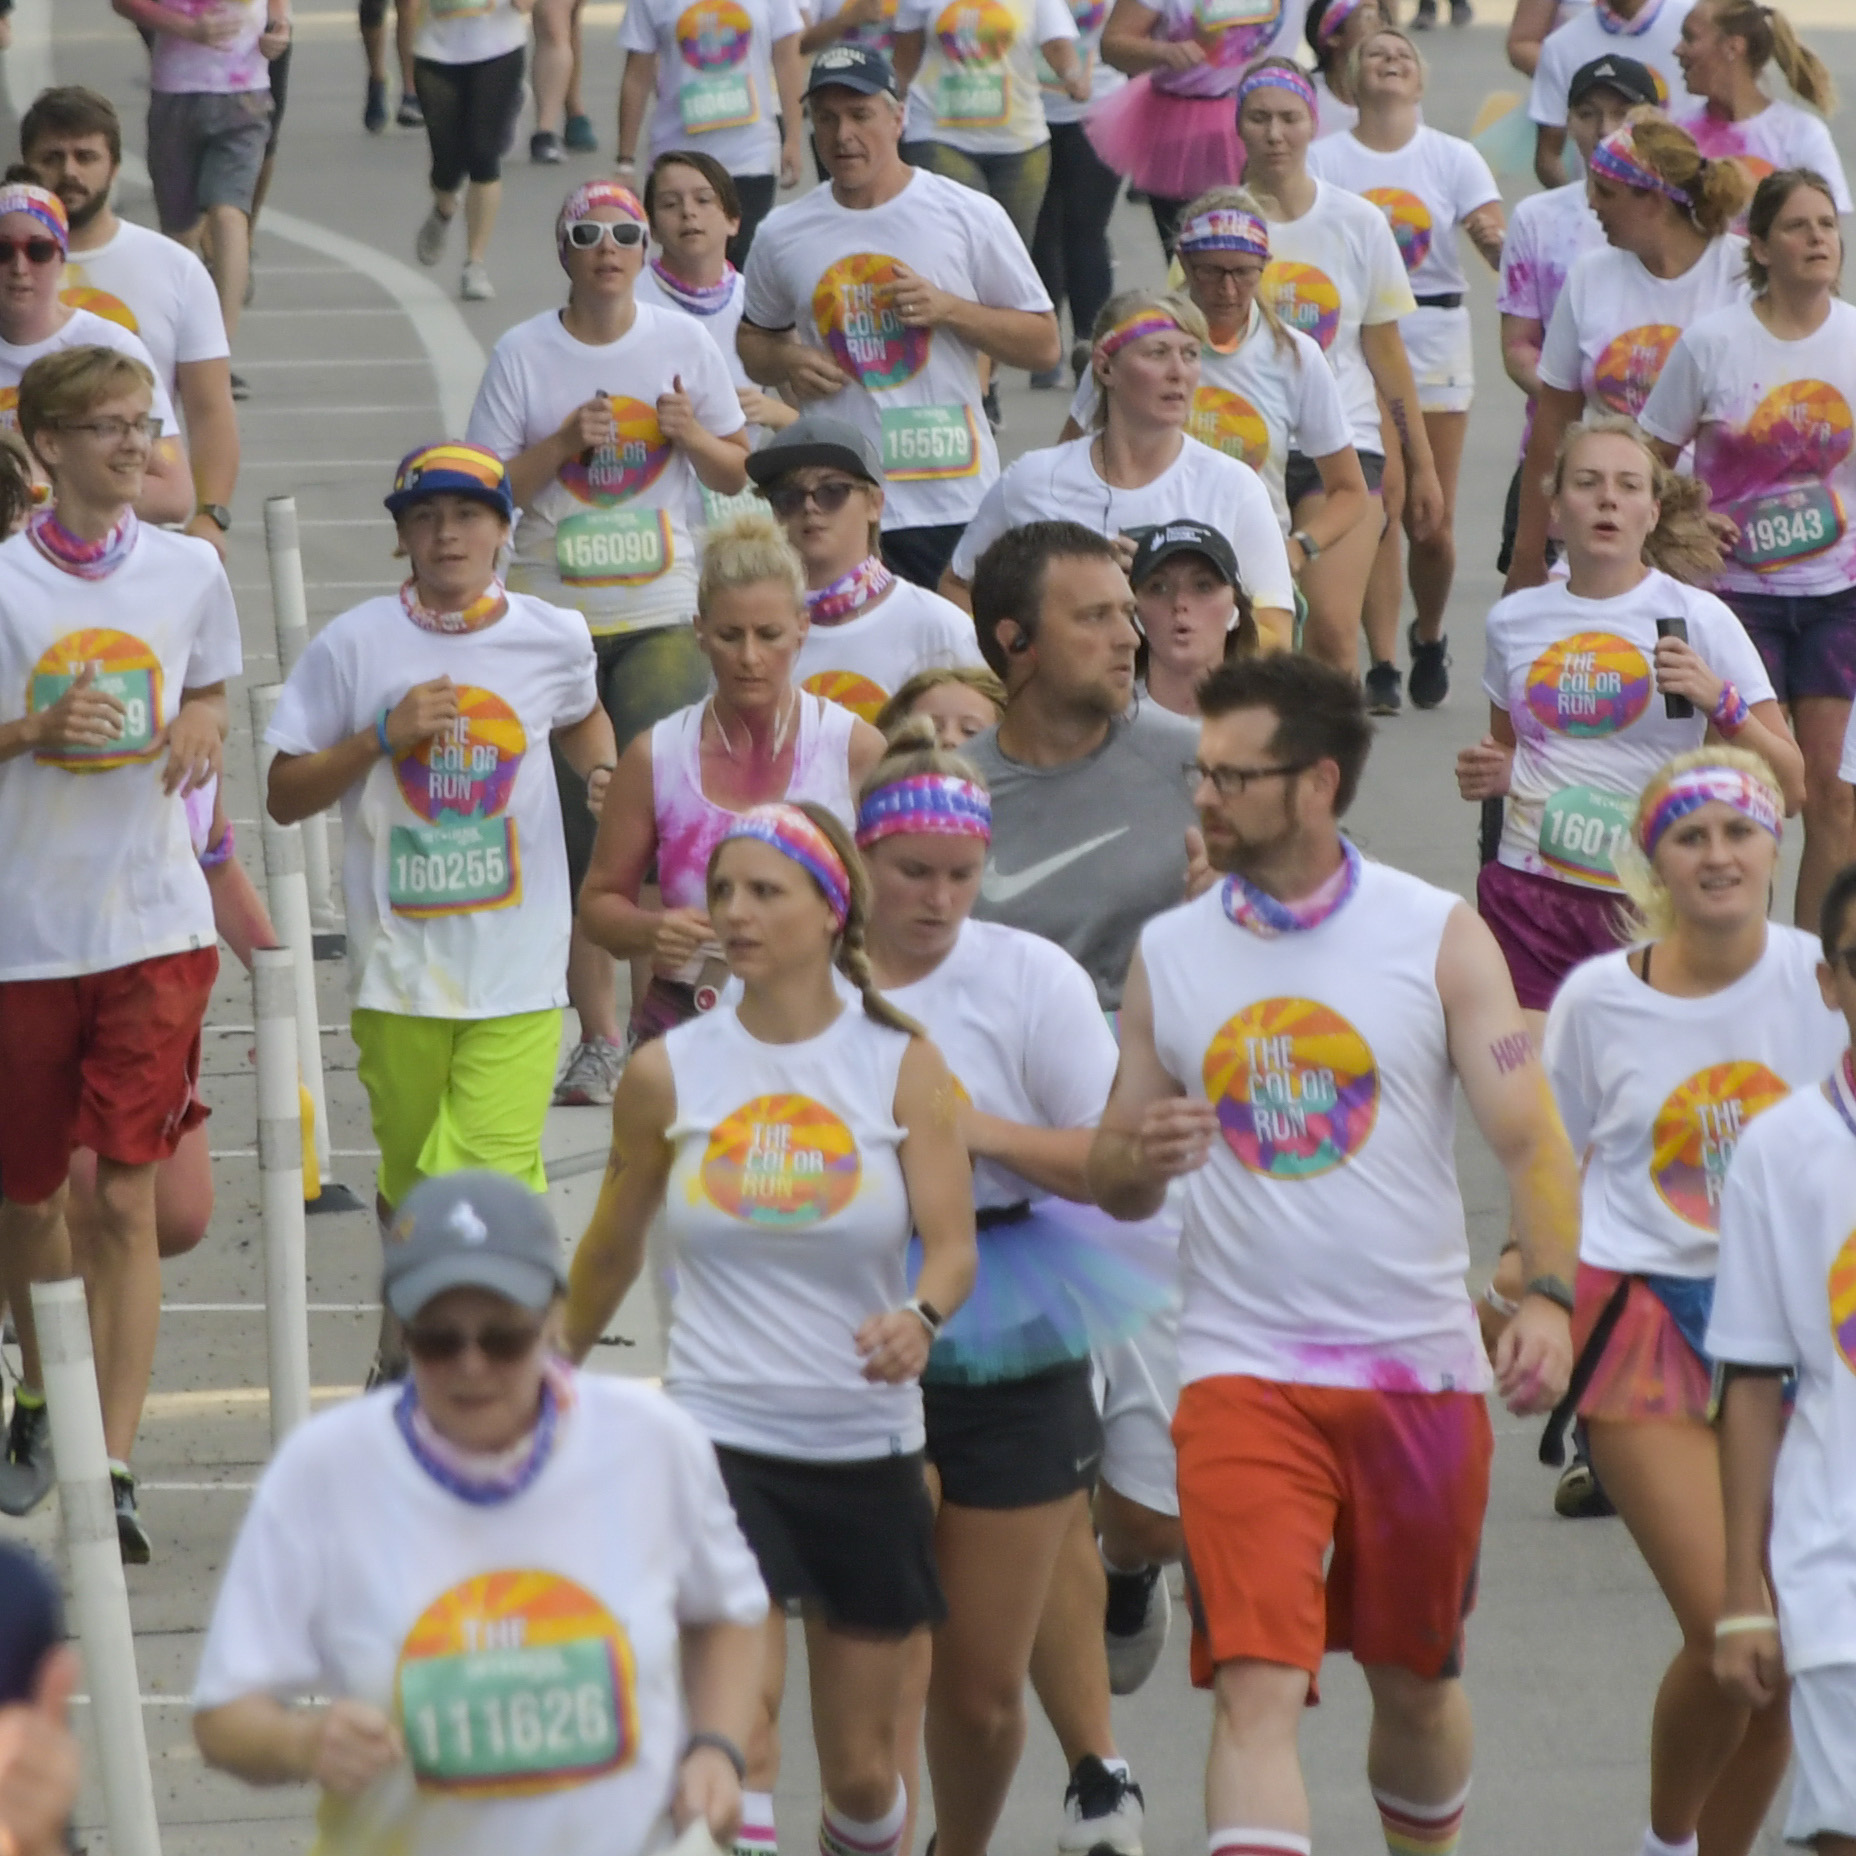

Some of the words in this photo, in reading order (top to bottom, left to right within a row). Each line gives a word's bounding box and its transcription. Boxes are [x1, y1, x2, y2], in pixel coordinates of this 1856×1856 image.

[842, 284, 875, 312] THE
[846, 336, 887, 363] RUN
[889, 427, 968, 460] 155579
[588, 464, 625, 488] RUN
[1745, 508, 1824, 553] 19343
[562, 531, 657, 568] 156090
[1564, 652, 1596, 674] THE
[1559, 671, 1622, 694] COLOR
[1558, 693, 1597, 716] RUN
[430, 745, 499, 773] COLOR
[429, 773, 472, 801] RUN
[393, 845, 504, 893] 160255
[1246, 1036, 1294, 1073] THE
[1248, 1067, 1338, 1106] COLOR
[1251, 1104, 1307, 1144] RUN
[1699, 1098, 1746, 1137] THE
[751, 1122, 792, 1152] THE
[746, 1147, 824, 1176] COLOR
[419, 1682, 610, 1763] 111626
